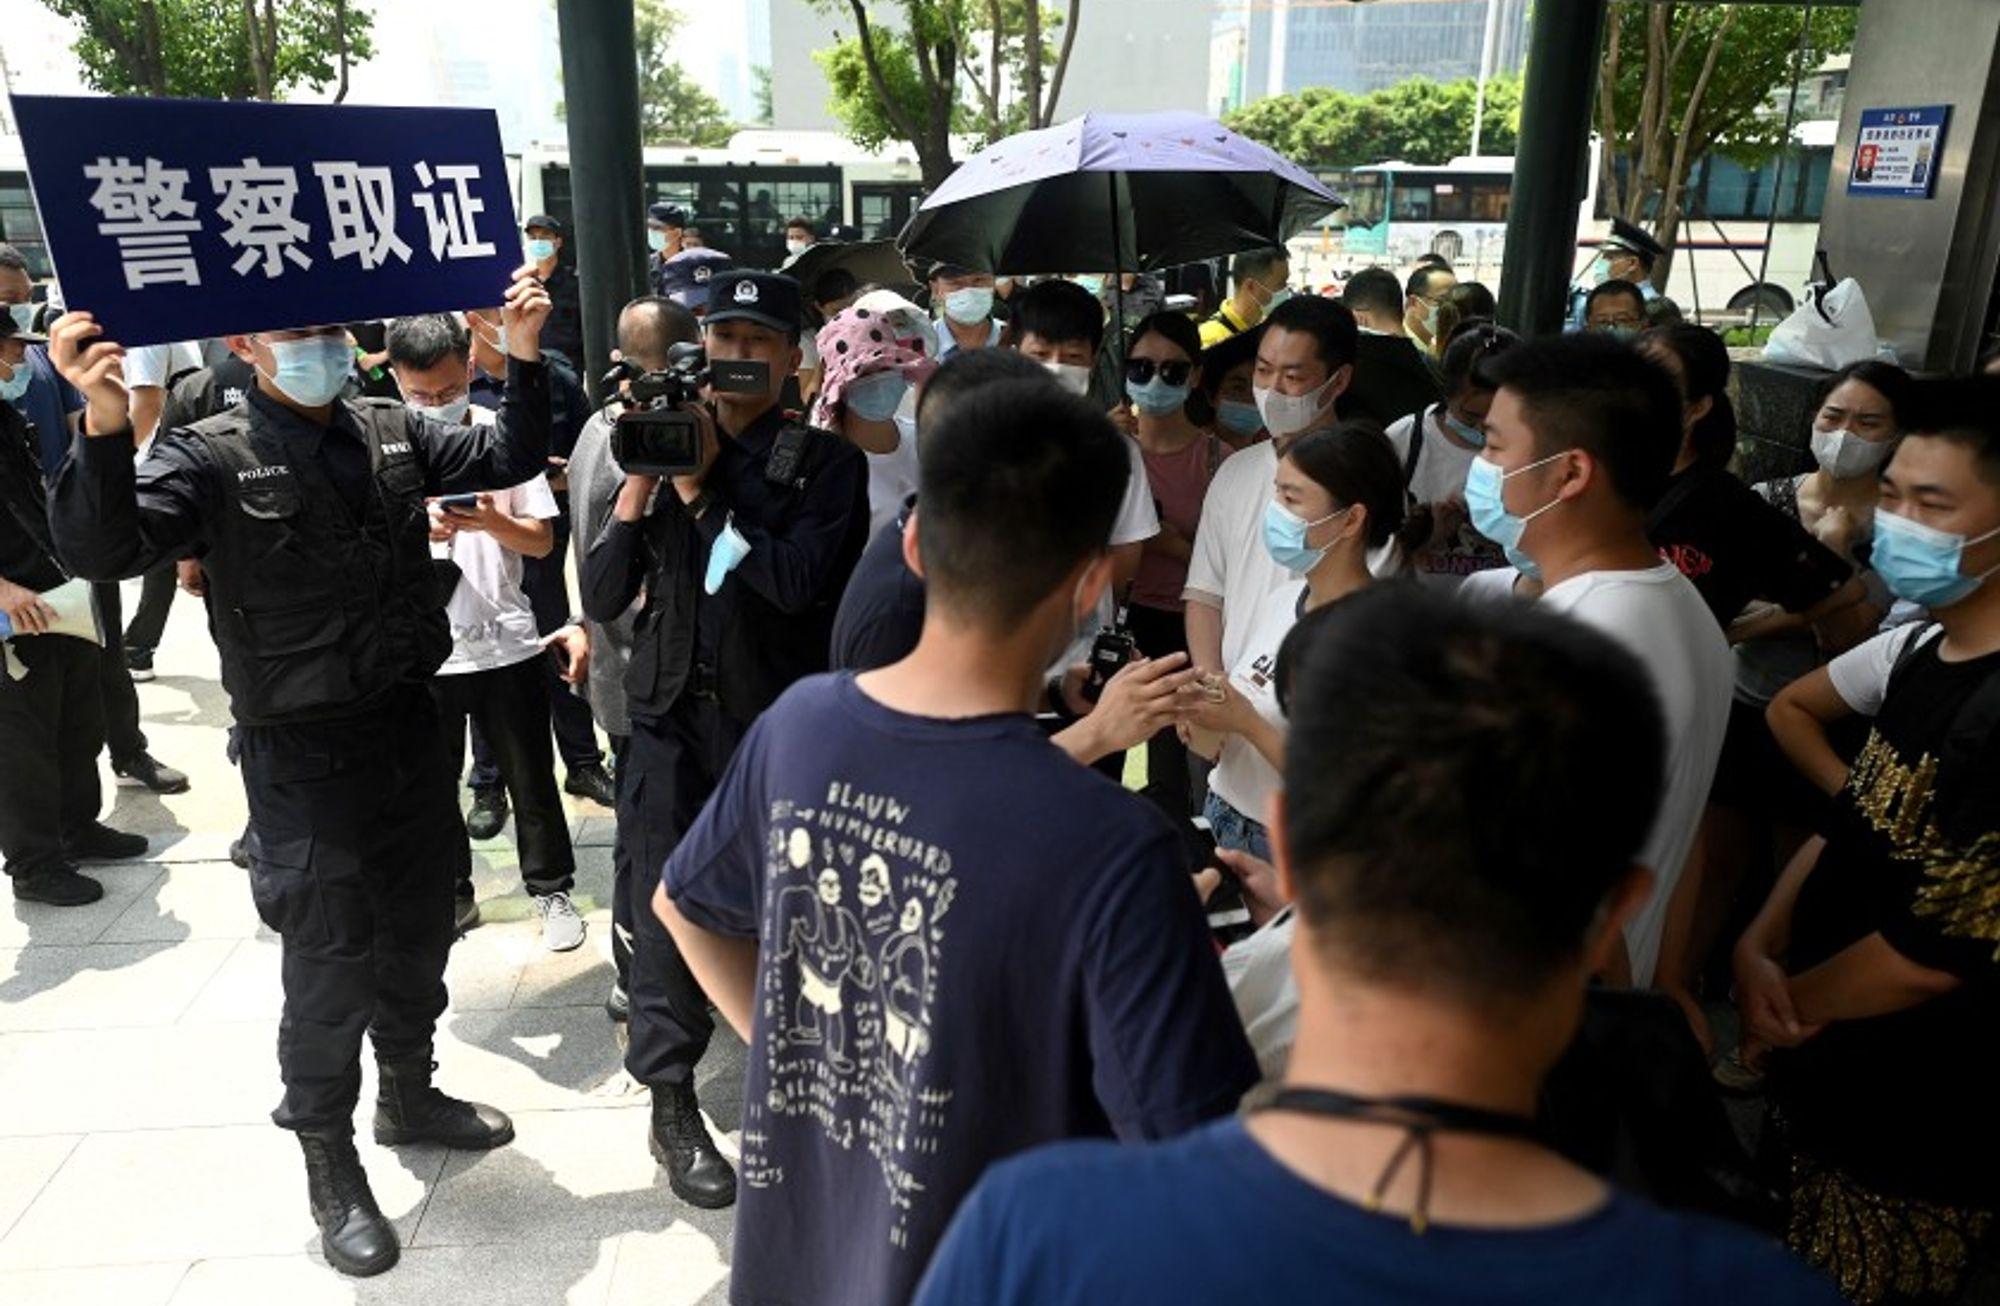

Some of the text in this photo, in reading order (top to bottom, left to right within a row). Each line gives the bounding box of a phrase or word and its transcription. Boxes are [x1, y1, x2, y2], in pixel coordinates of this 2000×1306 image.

[83, 157, 498, 291] 警察取证
[237, 465, 289, 483] POLICE
[827, 781, 911, 825] BLAUW
